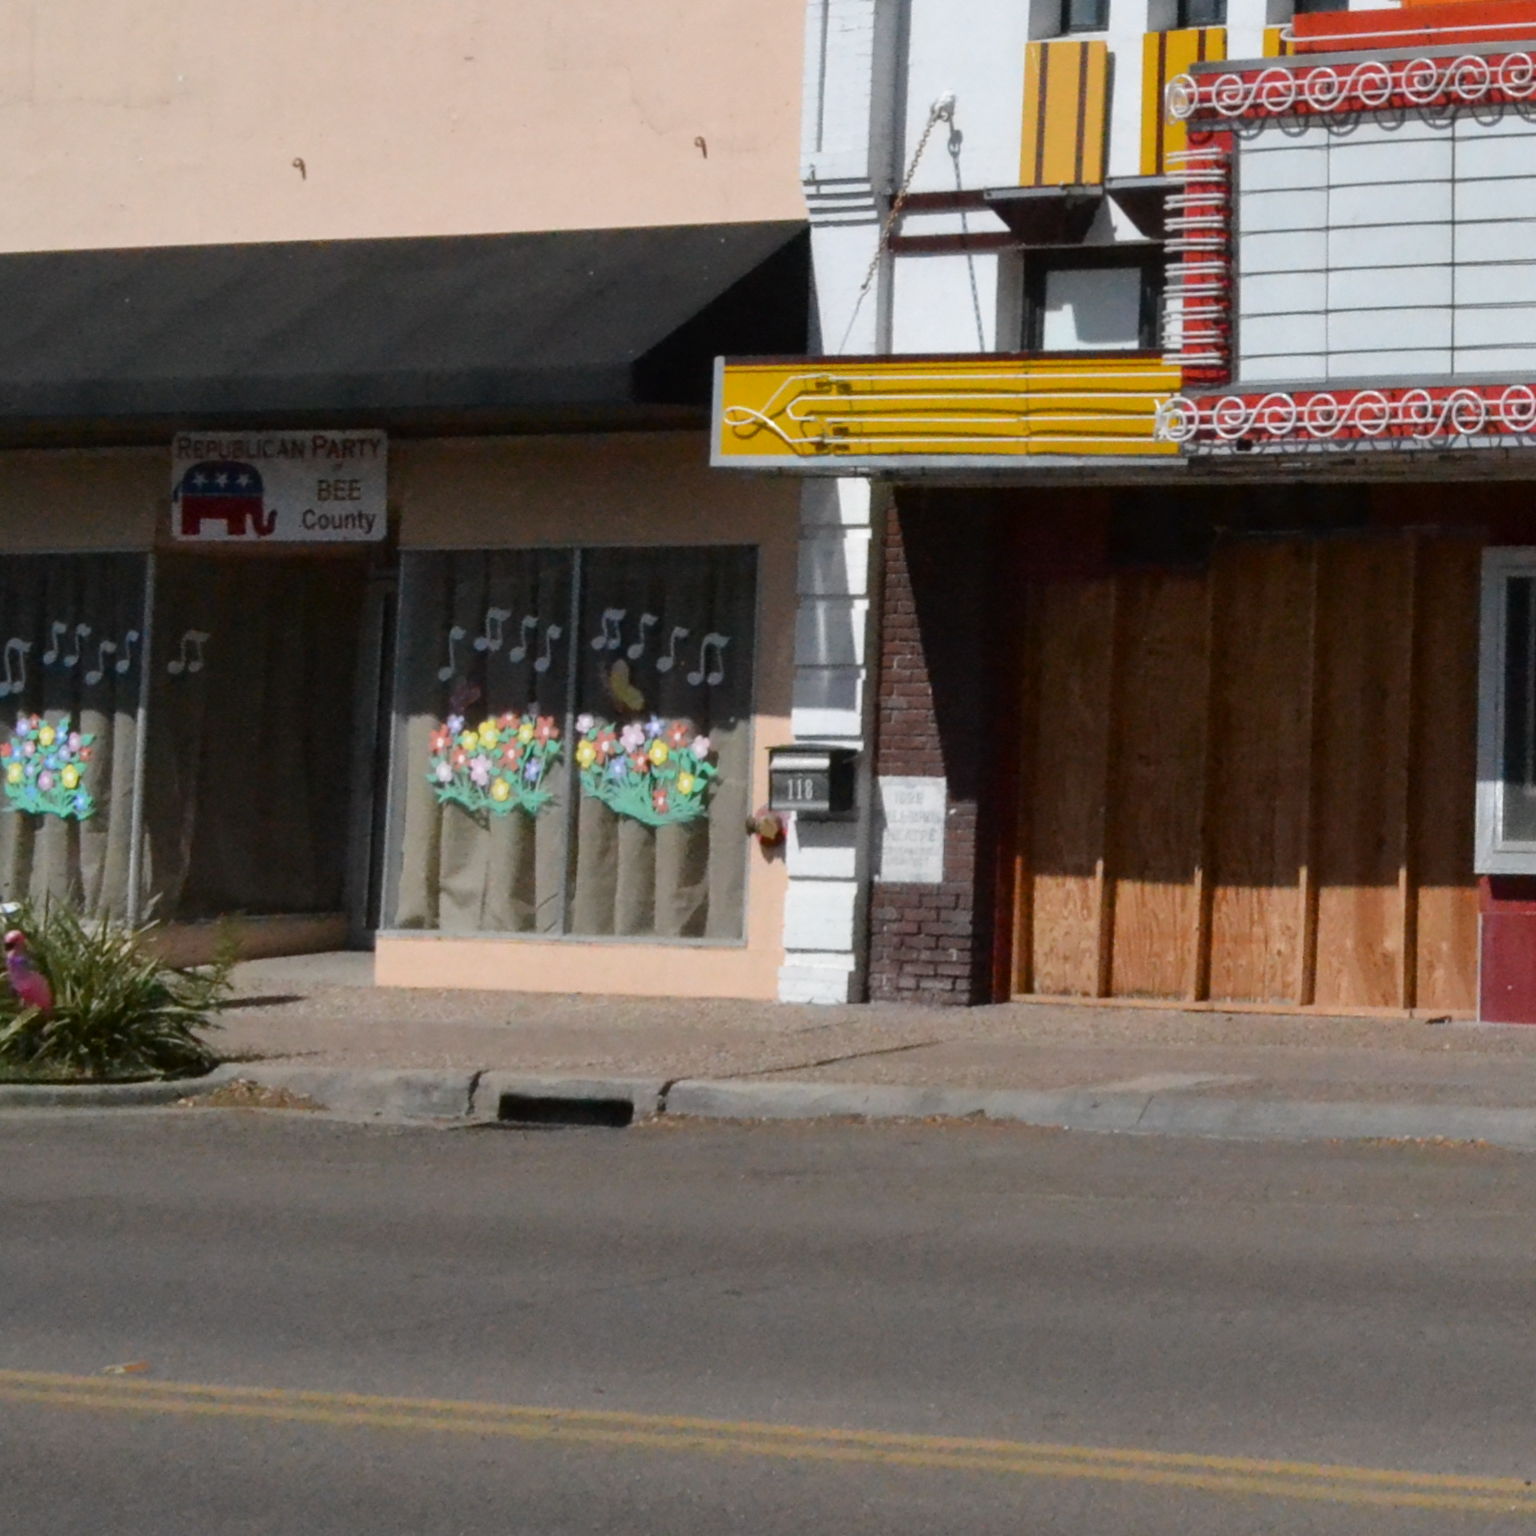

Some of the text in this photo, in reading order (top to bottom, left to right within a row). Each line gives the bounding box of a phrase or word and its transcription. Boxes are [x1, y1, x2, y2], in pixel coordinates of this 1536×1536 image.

[178, 434, 381, 460] REPUBLICAN PARTY
[316, 478, 362, 501] BEE
[302, 508, 377, 534] County
[787, 778, 814, 800] 118
